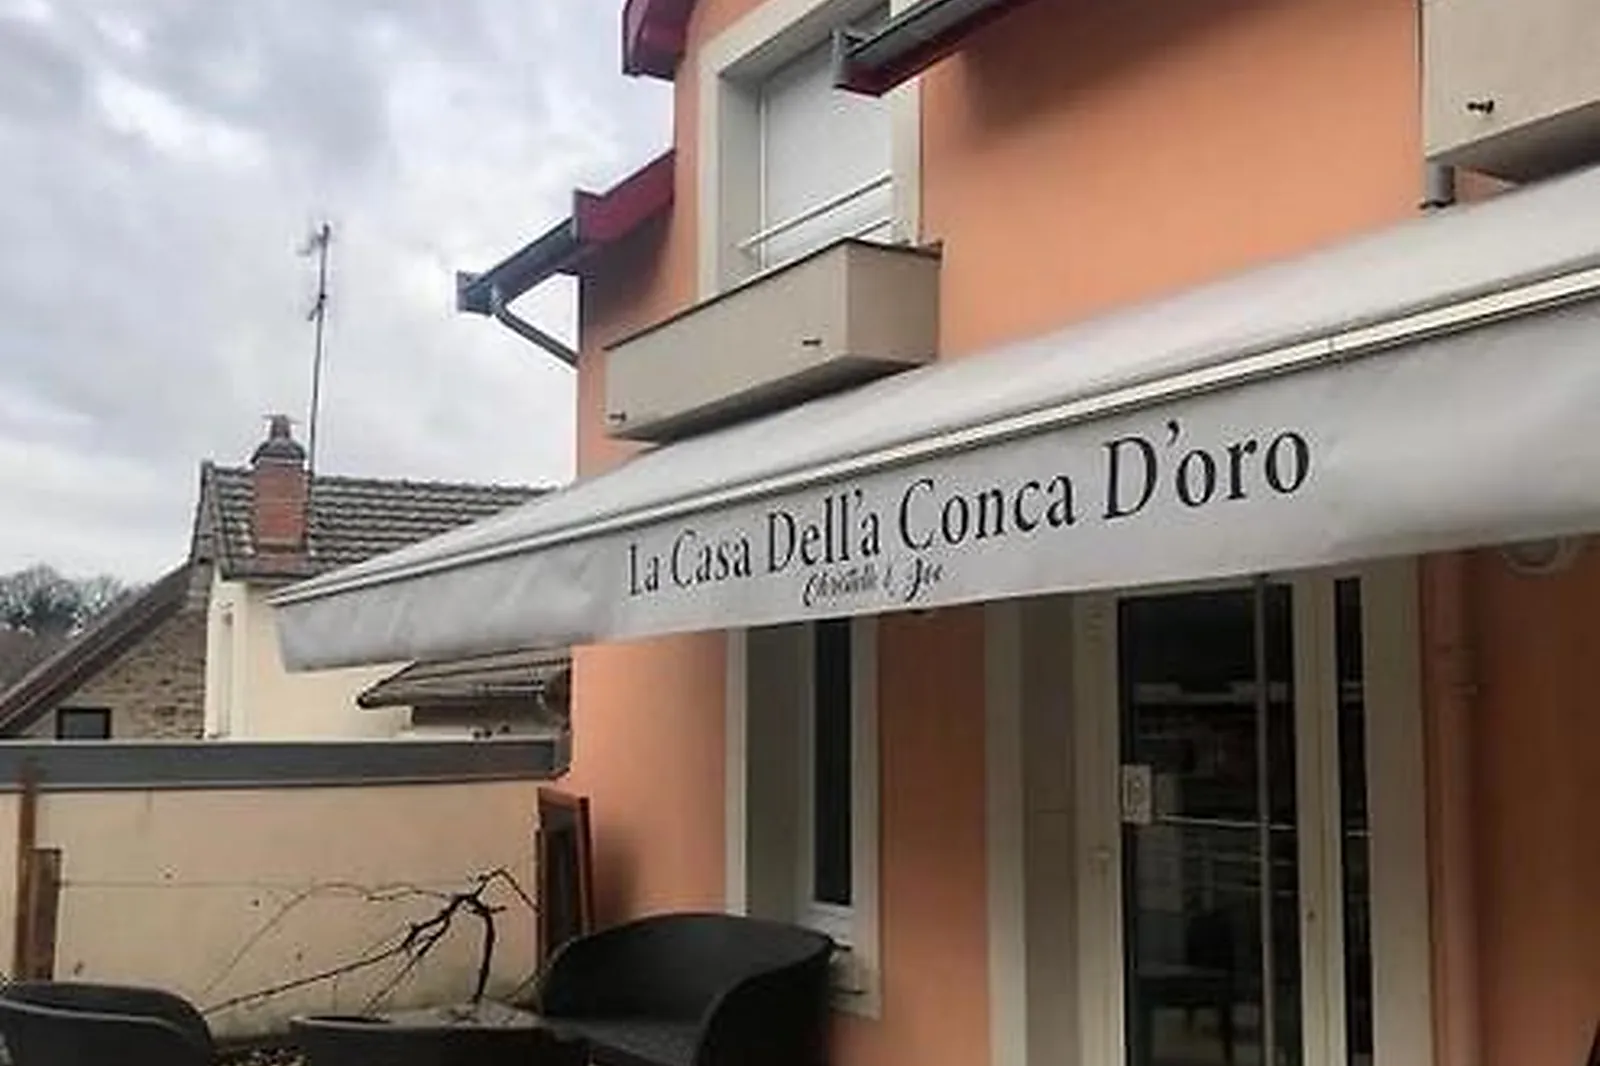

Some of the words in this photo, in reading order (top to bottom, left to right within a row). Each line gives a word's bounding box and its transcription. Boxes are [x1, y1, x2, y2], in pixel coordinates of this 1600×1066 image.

[629, 544, 660, 596] La
[671, 528, 752, 589] Casa
[900, 476, 1077, 550] Conca
[1101, 419, 1310, 520] D'oro
